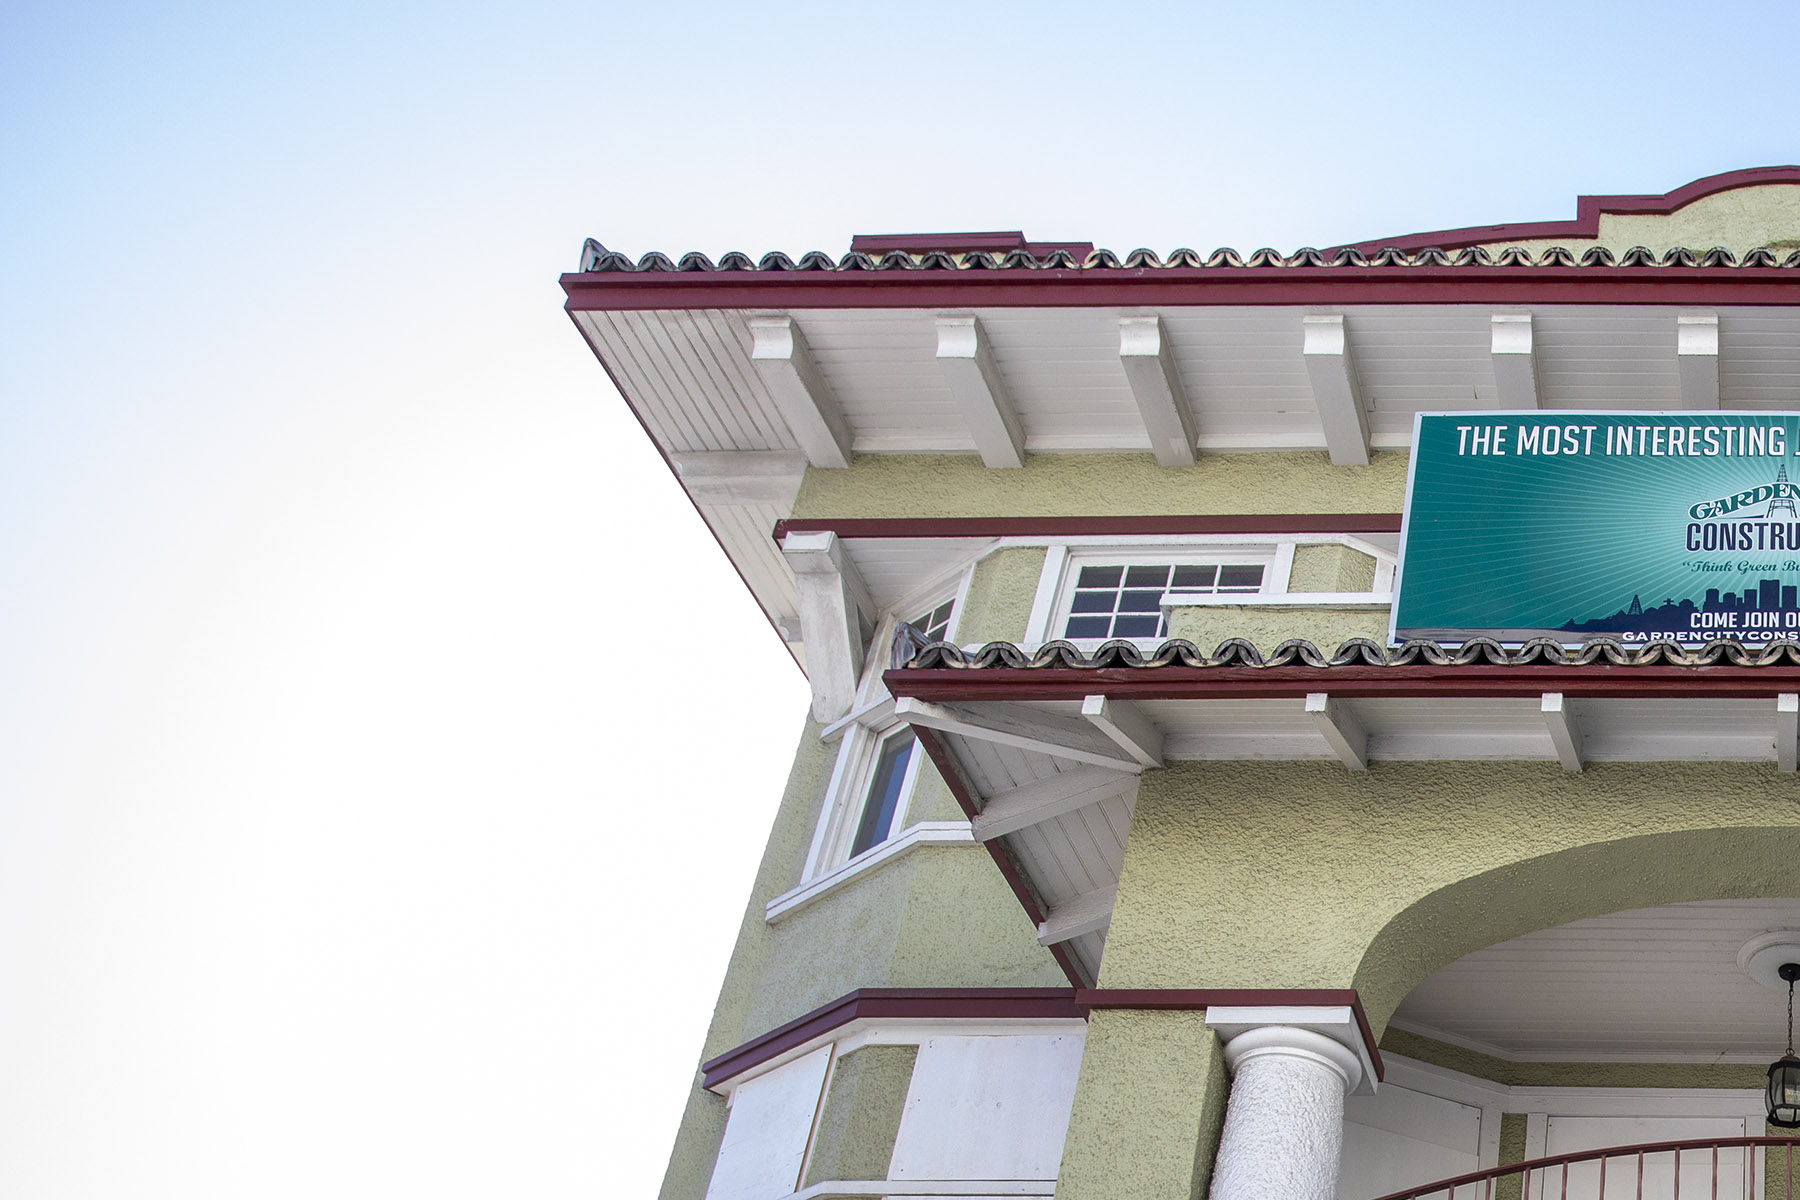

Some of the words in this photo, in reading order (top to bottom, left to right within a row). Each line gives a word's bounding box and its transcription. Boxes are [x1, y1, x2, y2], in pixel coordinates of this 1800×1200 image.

[1456, 425, 1508, 456] THE
[1516, 425, 1597, 456] MOST
[1605, 425, 1786, 457] INTERESTING
[1736, 560, 1778, 575] Green
[1689, 611, 1738, 629] COME
[1741, 611, 1780, 629] JOIN
